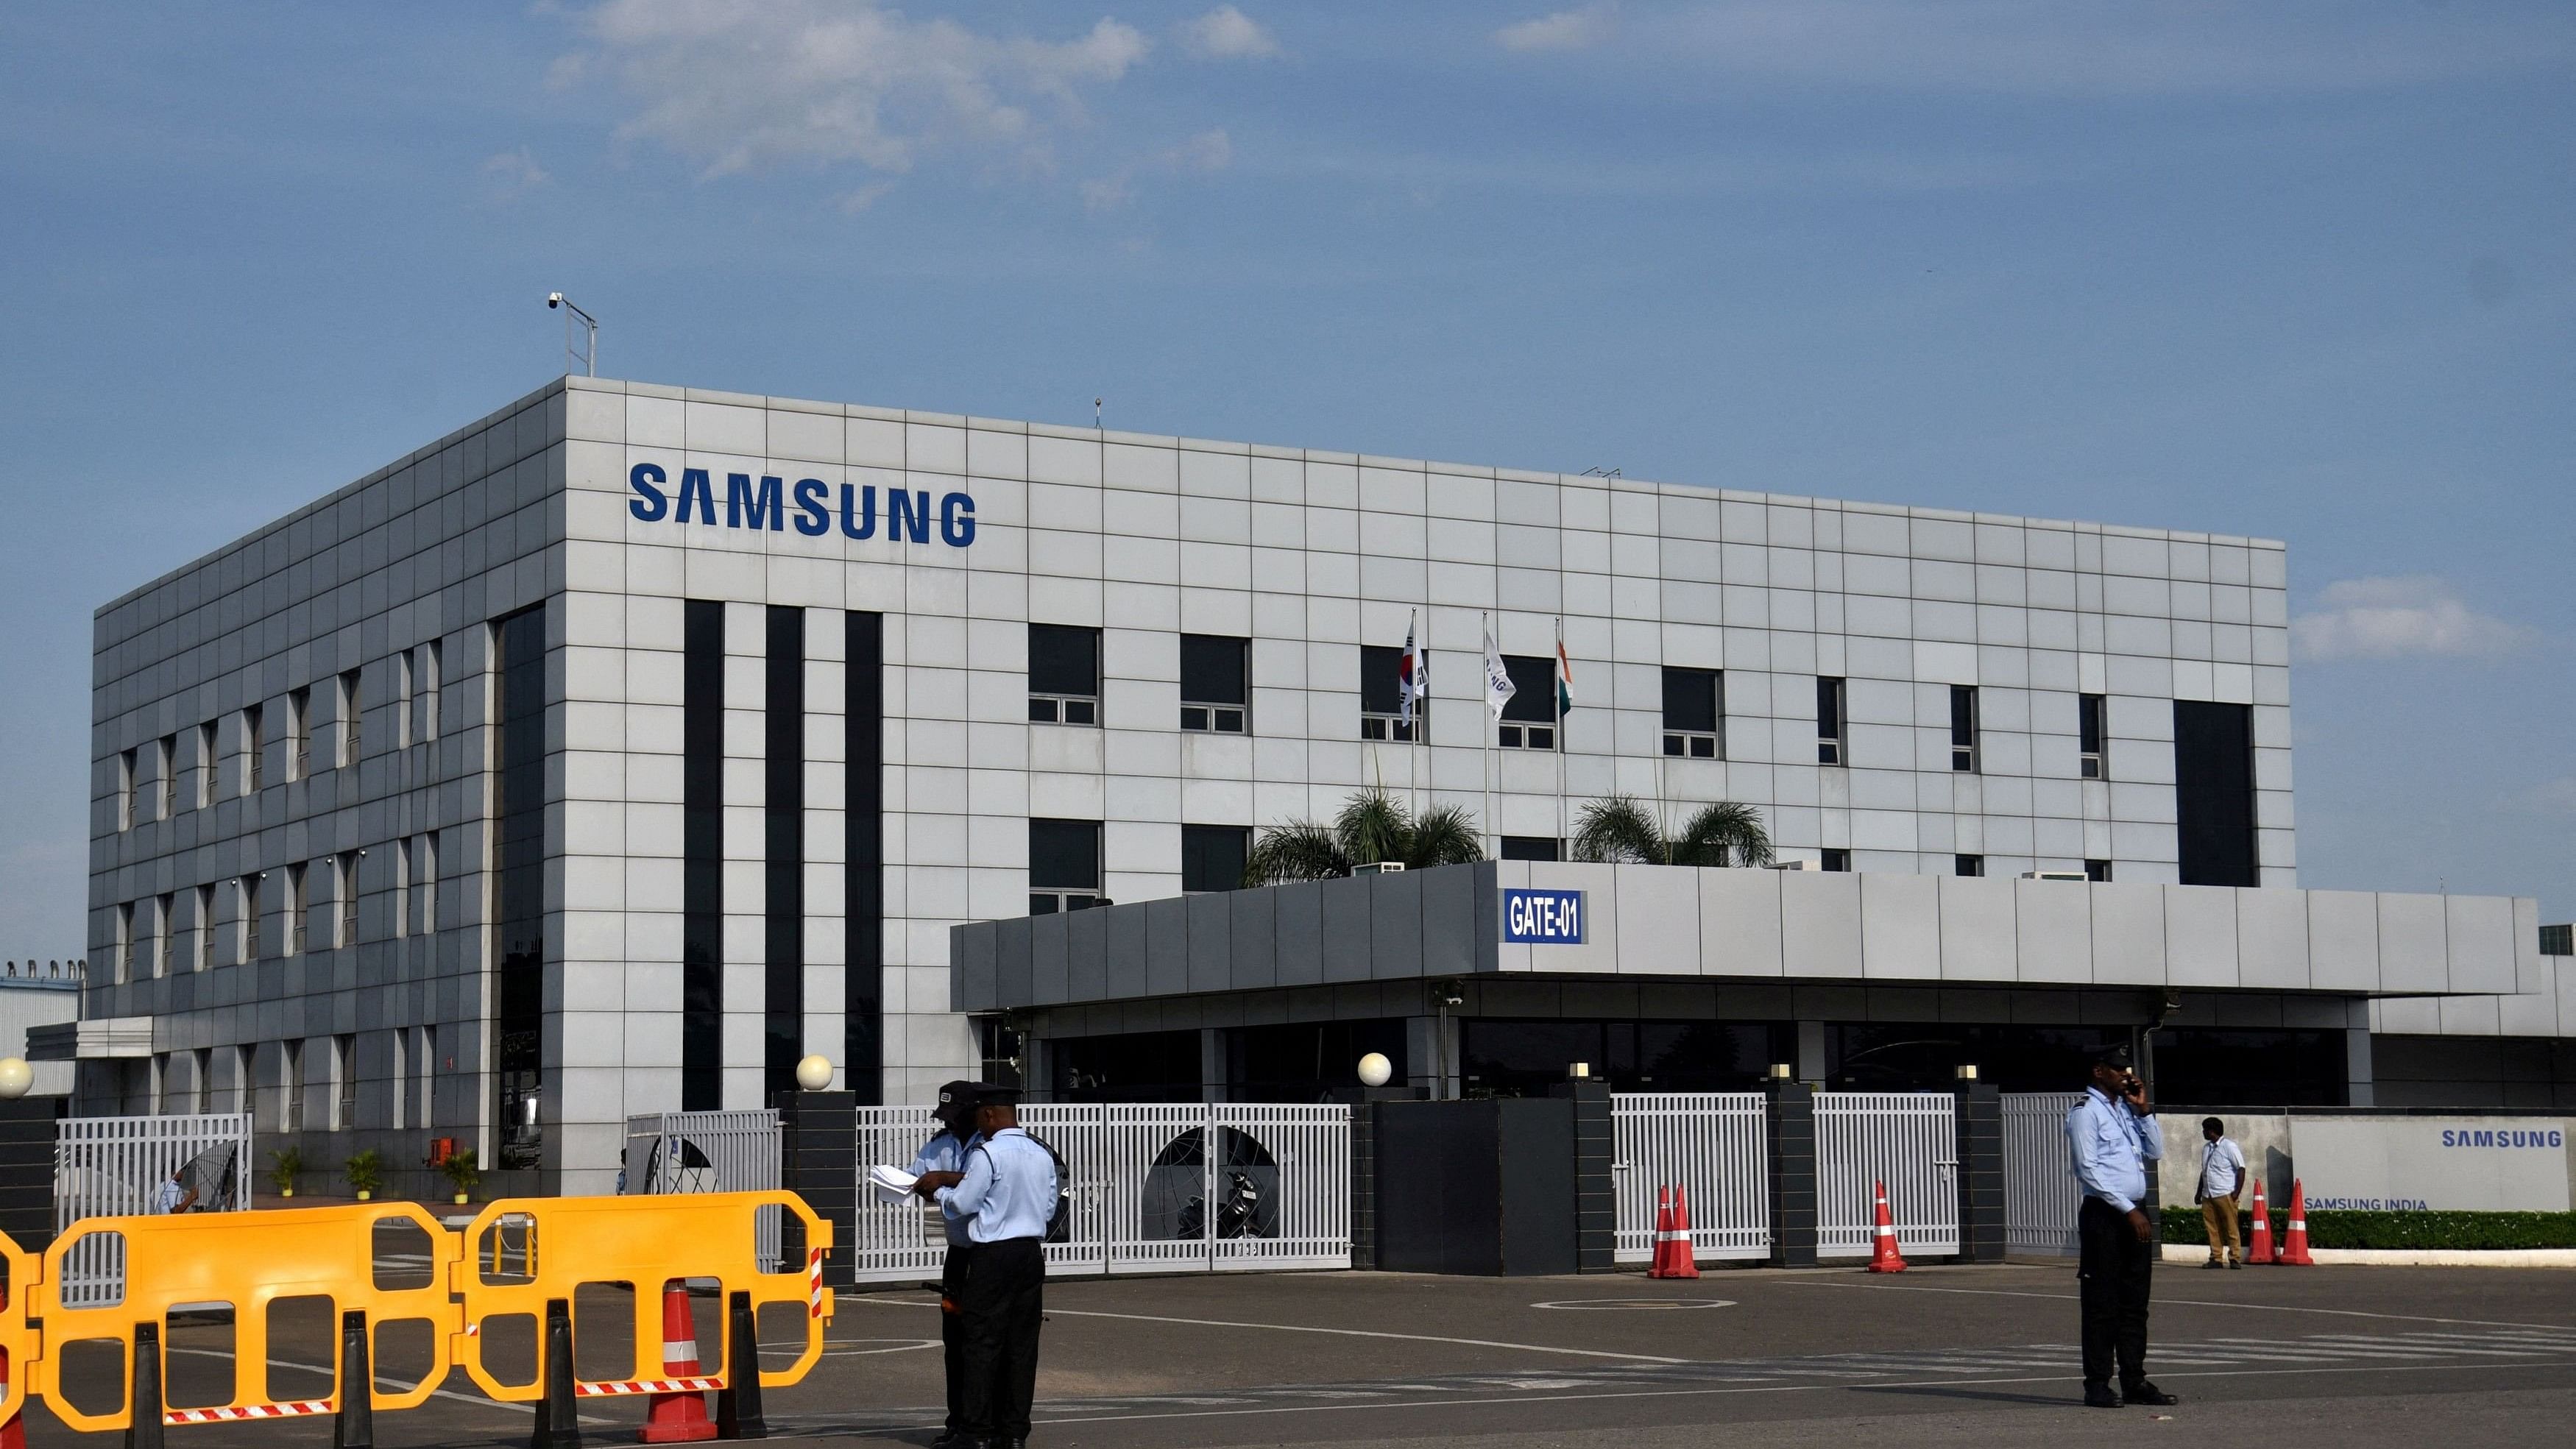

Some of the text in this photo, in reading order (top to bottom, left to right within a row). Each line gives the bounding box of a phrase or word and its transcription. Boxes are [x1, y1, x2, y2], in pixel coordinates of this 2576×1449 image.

[629, 463, 975, 547] SAMSUNG
[1510, 896, 1577, 937] GATE-01
[2442, 1130, 2561, 1147] SAMSUNG
[2304, 1198, 2427, 1211] SAMSUNG INDIA
